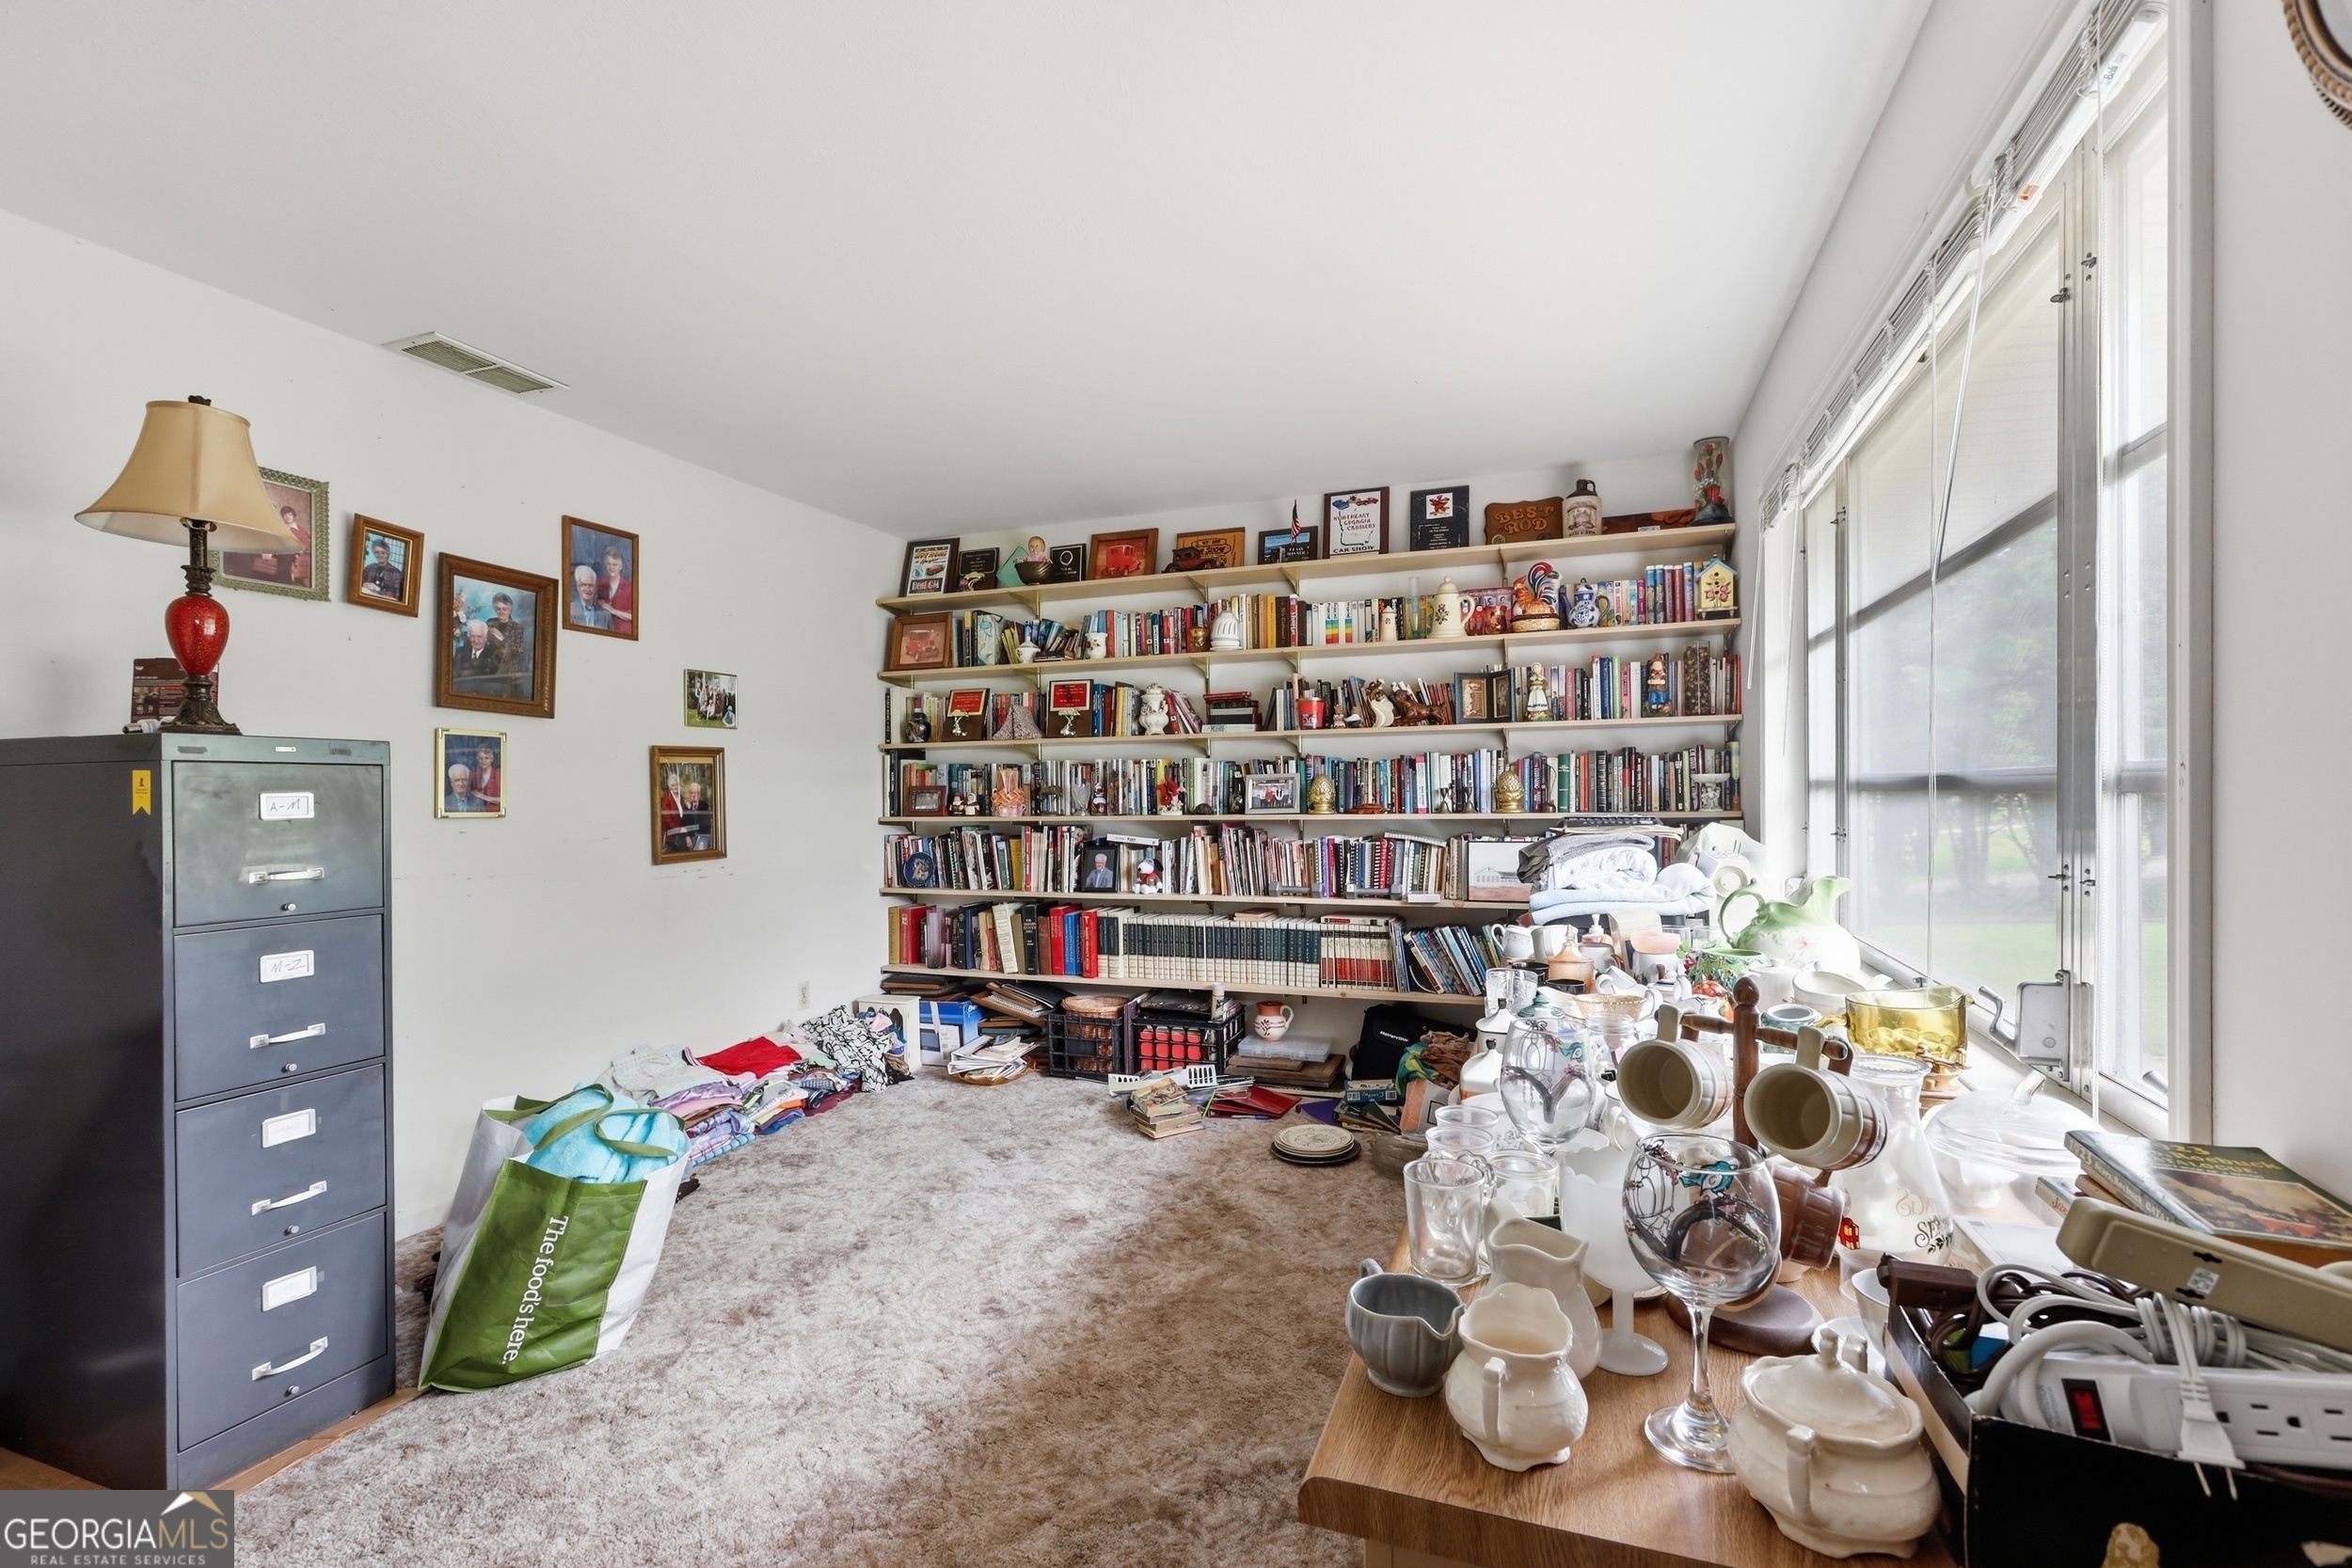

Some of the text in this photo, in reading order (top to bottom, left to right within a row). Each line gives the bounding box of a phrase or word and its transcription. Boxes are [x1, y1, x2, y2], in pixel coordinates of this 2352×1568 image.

[1495, 505, 1554, 524] BEST
[1504, 517, 1548, 534] ROD
[2070, 1139, 2092, 1165] 1923
[2114, 1176, 2143, 1203] Roebuck
[501, 1215, 569, 1365] The food's here.
